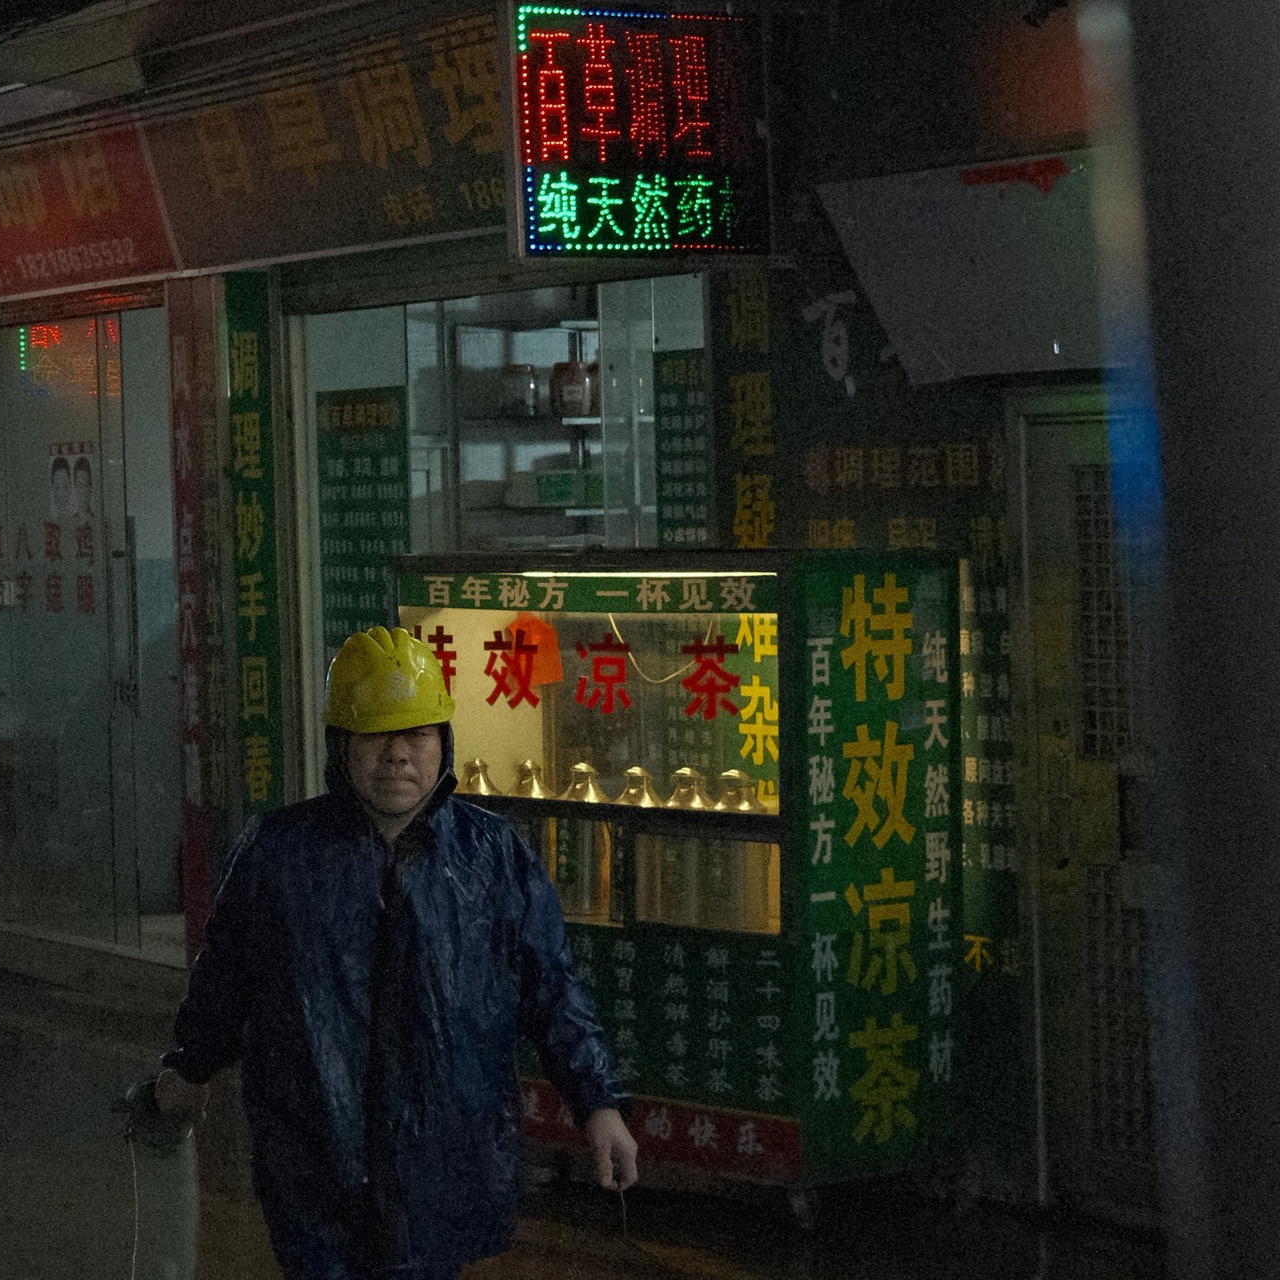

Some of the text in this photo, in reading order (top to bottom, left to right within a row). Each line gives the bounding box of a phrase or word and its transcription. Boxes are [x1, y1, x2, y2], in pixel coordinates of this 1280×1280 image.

[232, 330, 273, 802] 调理妙手回春
[423, 575, 757, 612] 百年秘方 一杯见效
[756, 949, 784, 1102] 二十四味茶
[806, 635, 840, 1103] 百年秘方一杯见效
[839, 572, 919, 1146] 特效凉茶
[921, 631, 956, 1085] 纯天然野生药材
